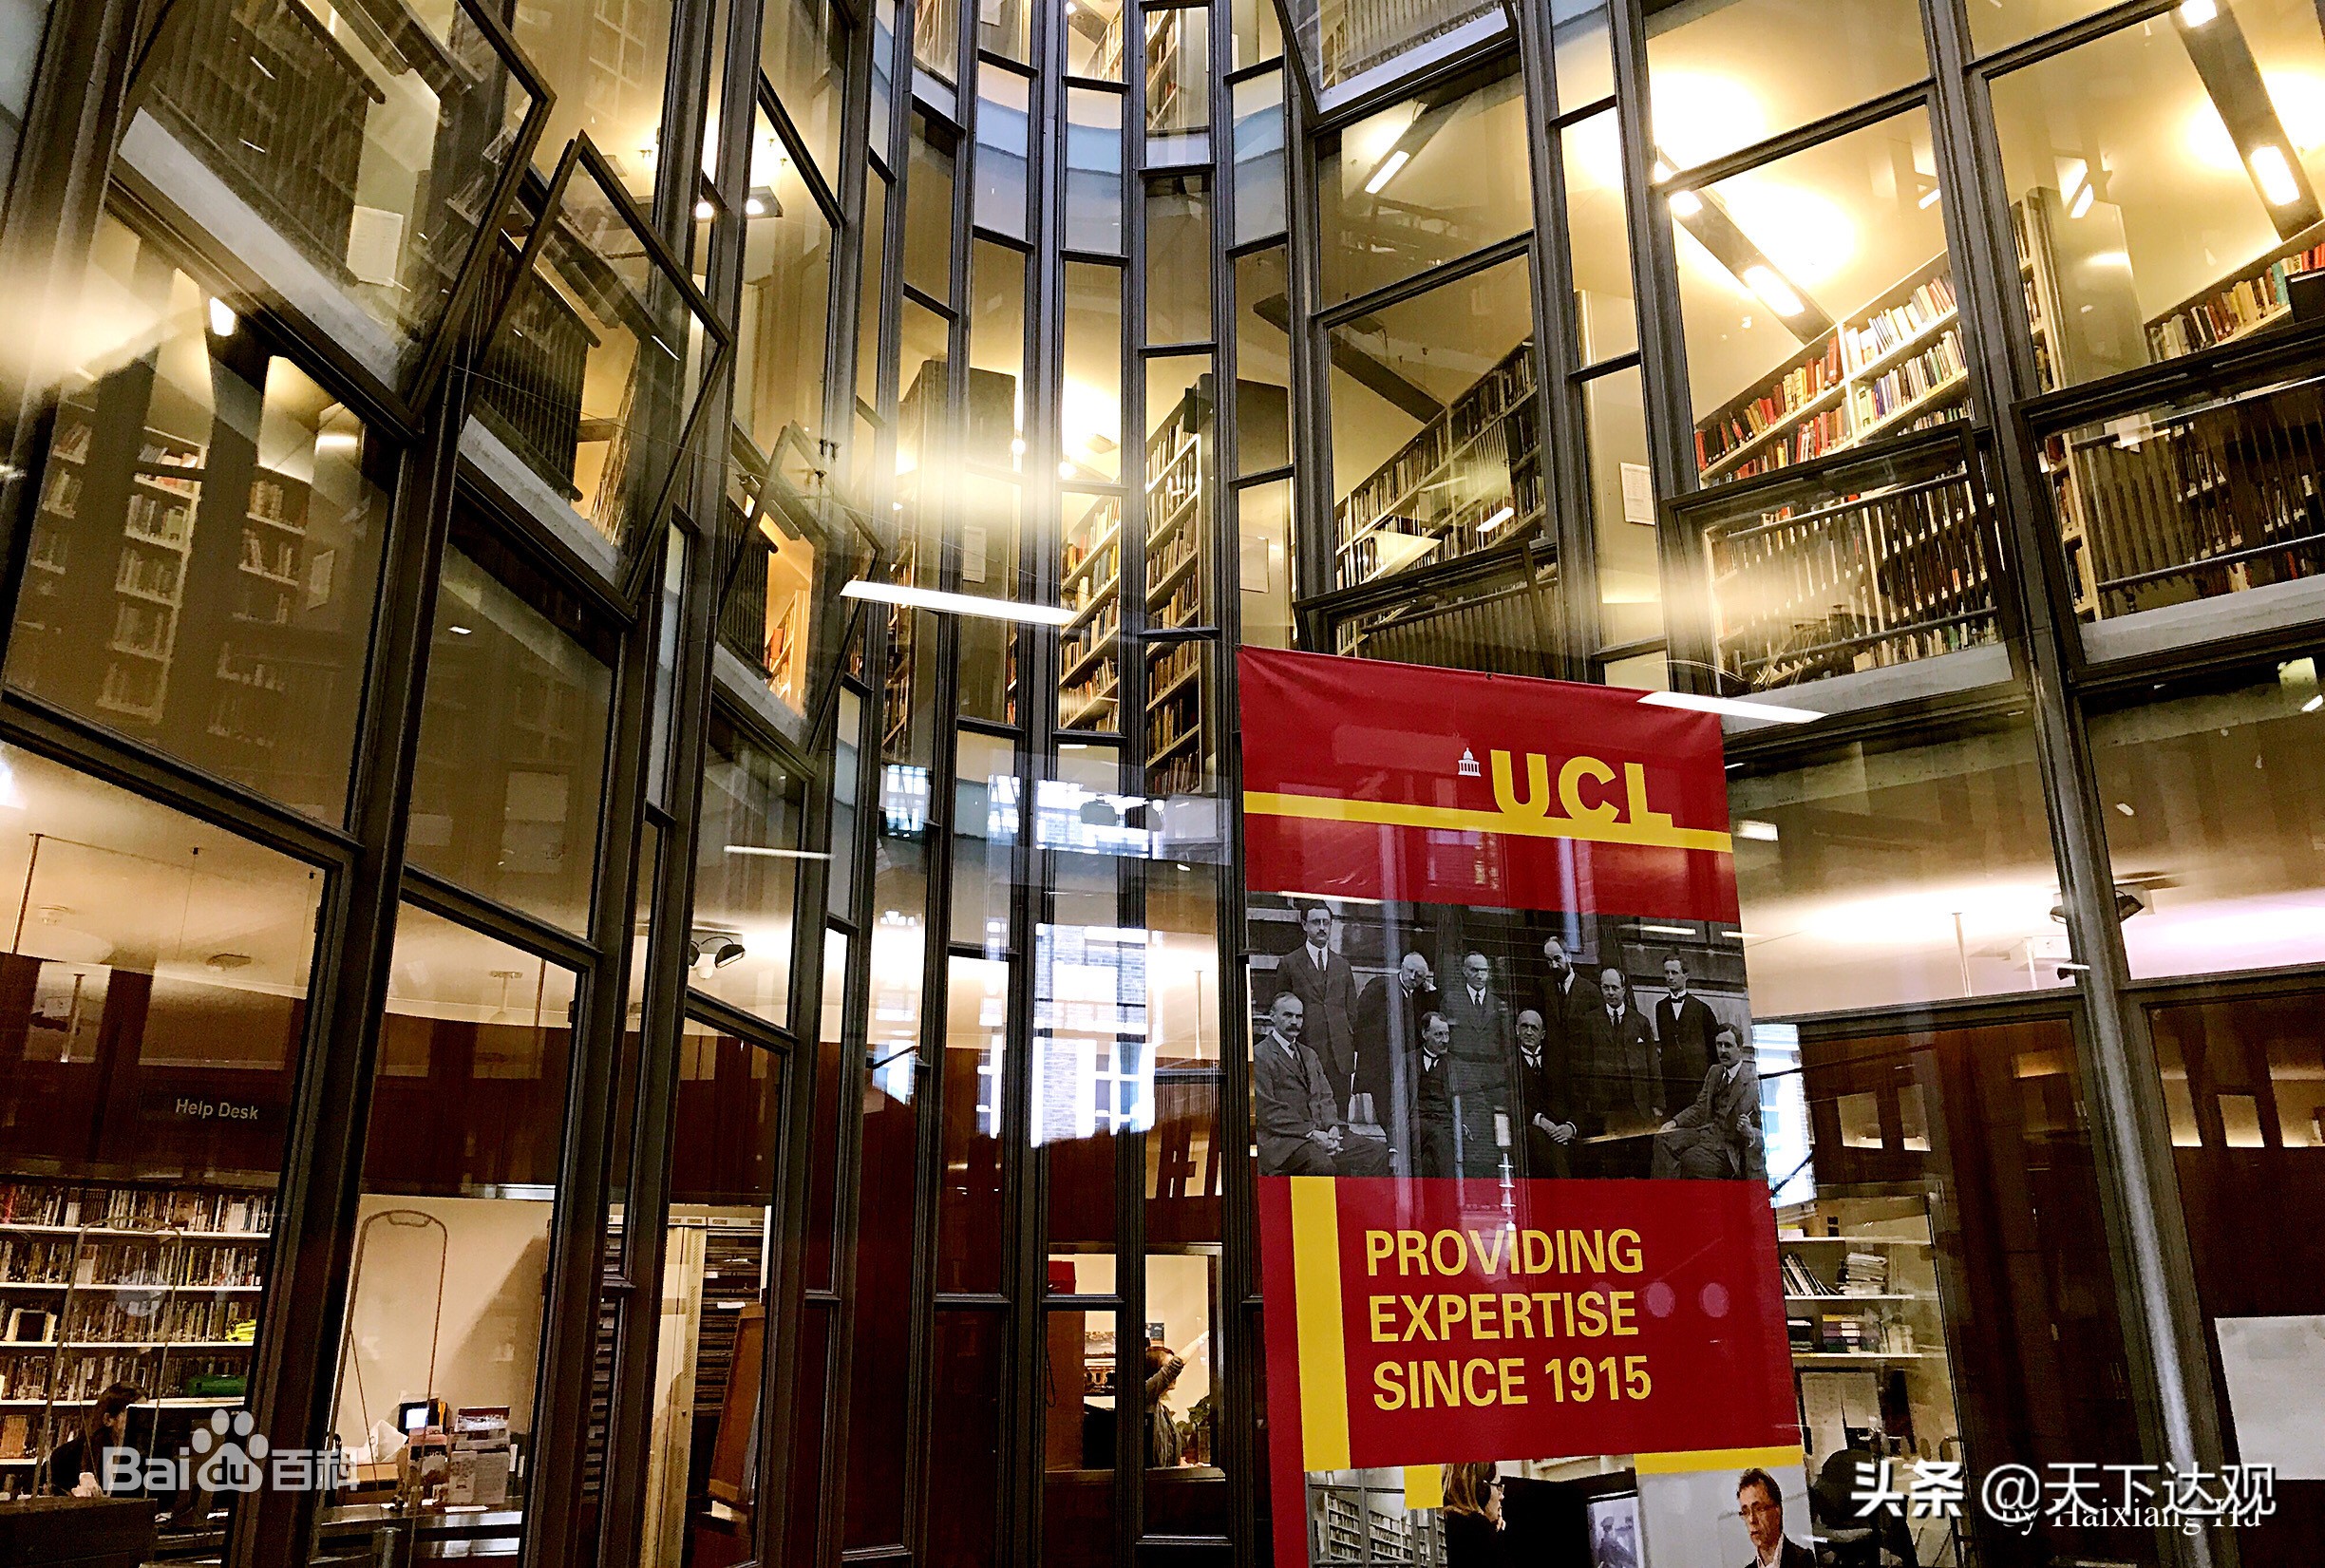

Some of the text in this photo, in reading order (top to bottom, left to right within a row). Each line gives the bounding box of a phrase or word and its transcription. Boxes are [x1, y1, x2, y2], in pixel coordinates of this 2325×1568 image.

[1490, 750, 1673, 826] UCL
[175, 1098, 258, 1120] Help Desk
[1366, 1228, 1644, 1276] PROVIDING
[1369, 1291, 1639, 1342] EXPERTISE
[1373, 1355, 1652, 1410] SINCE 1915
